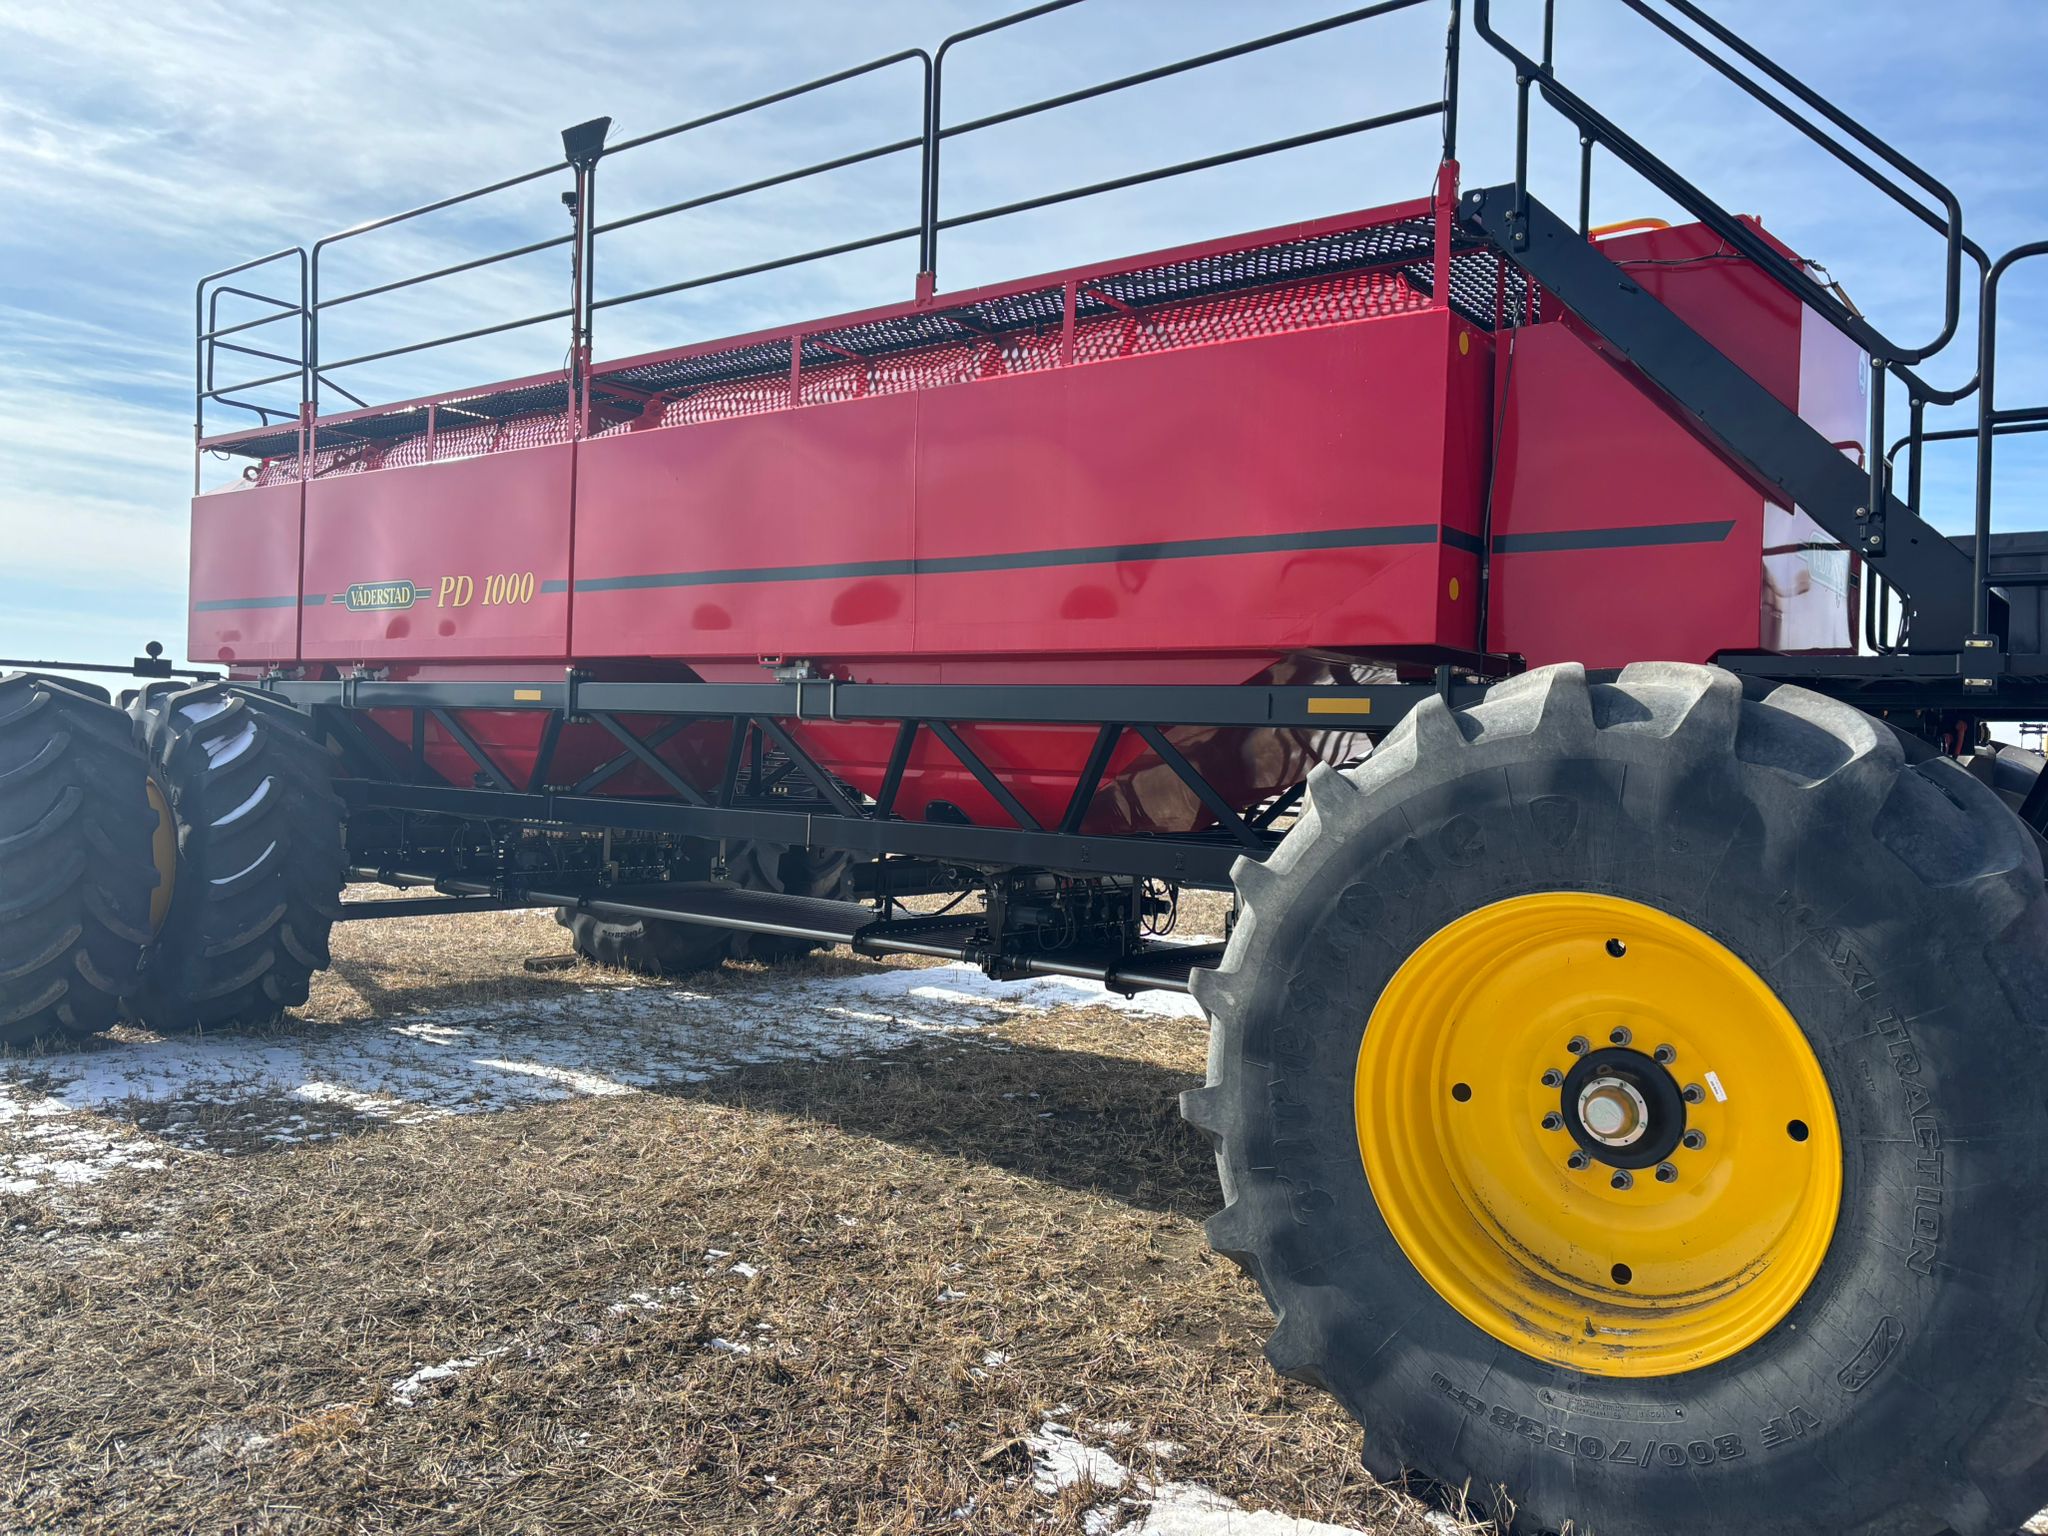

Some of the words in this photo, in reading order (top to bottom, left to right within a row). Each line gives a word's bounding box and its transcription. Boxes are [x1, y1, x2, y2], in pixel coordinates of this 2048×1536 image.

[351, 584, 411, 606] VÄDERSTAD
[437, 575, 474, 608] PD
[481, 571, 535, 605] 1000
[1875, 1007, 1944, 1274] TRACTION
[1489, 1404, 1746, 1468] 800/70R38
[1759, 1405, 1822, 1450] VF
